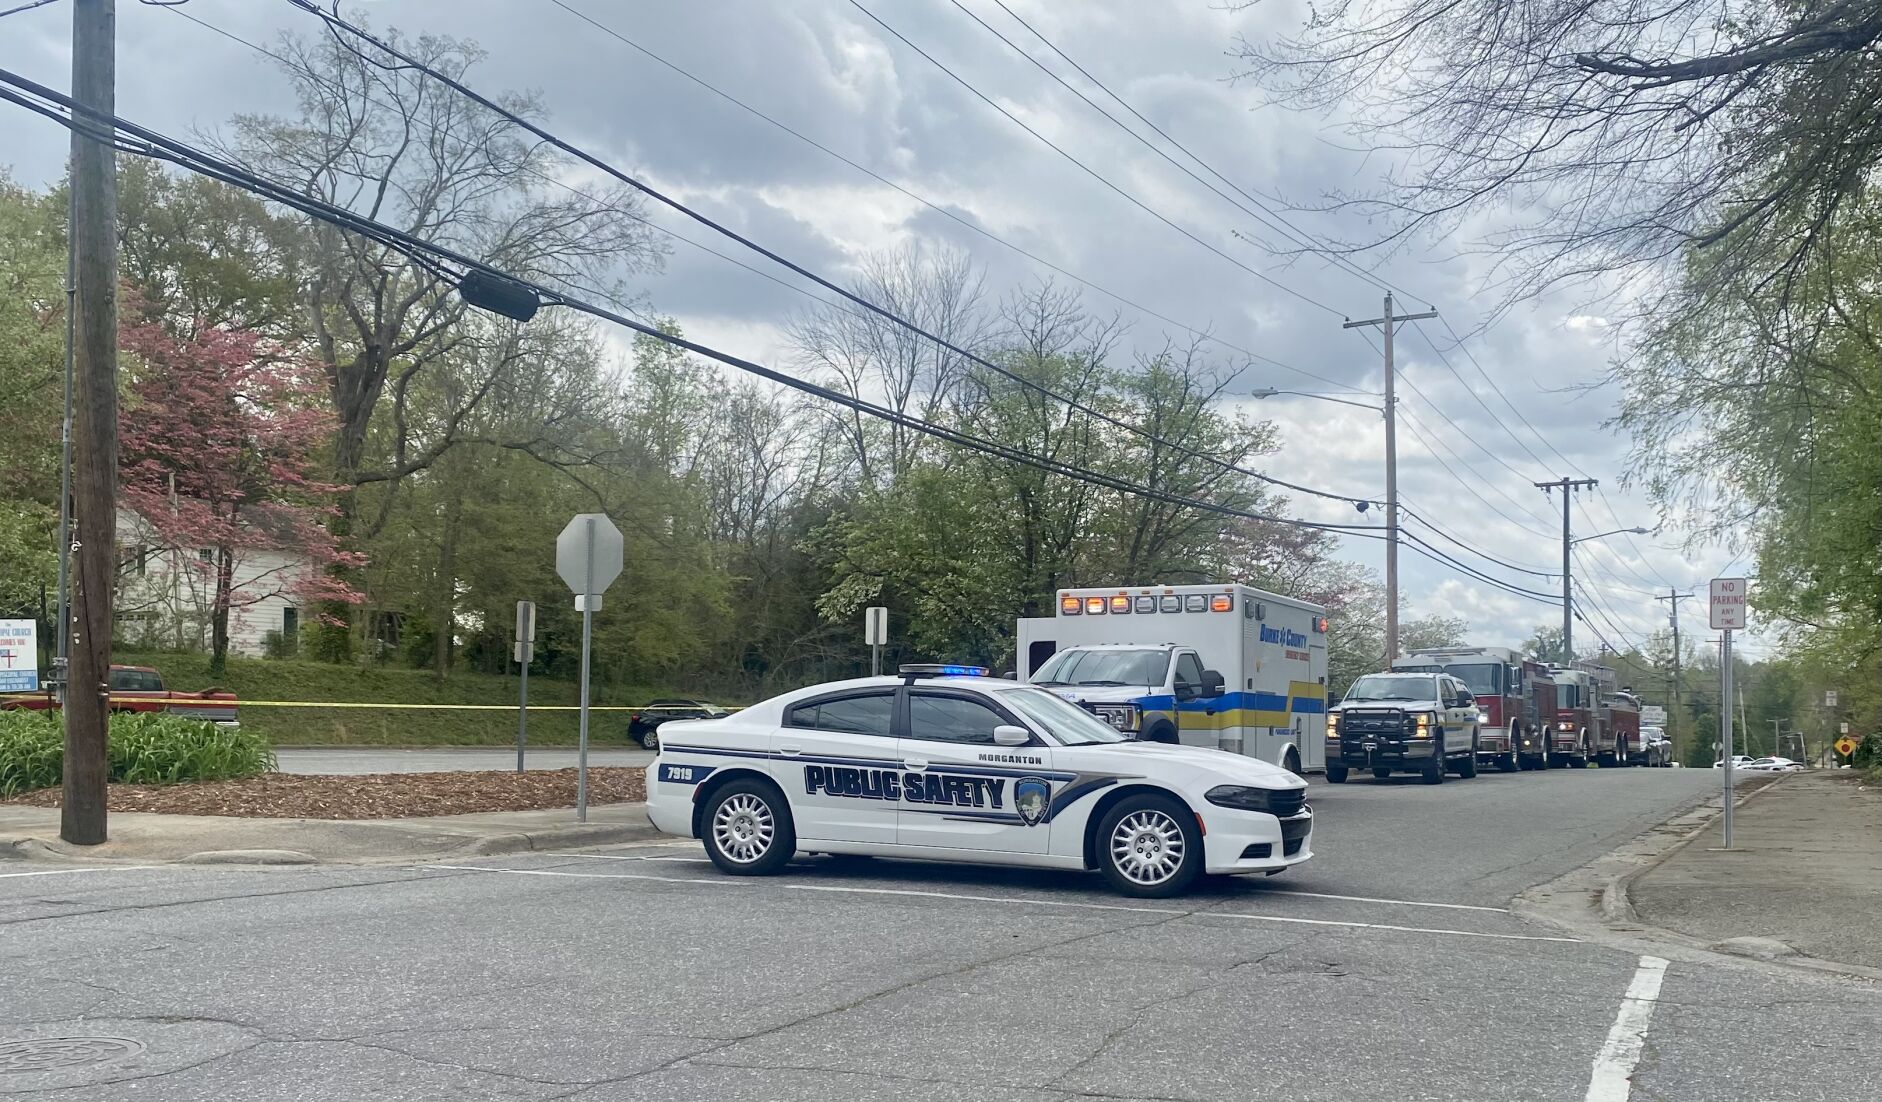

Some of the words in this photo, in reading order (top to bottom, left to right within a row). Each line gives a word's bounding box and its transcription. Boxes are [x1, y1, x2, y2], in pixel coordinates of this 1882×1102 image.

[1721, 582, 1735, 592] NO
[1712, 595, 1744, 605] PARKING
[1721, 608, 1734, 616] ANY
[1721, 618, 1735, 626] TIME
[978, 753, 1042, 765] MORGANTON
[667, 766, 693, 781] 7919
[804, 765, 901, 801] PUBLIC
[902, 772, 1006, 809] SAFETY
